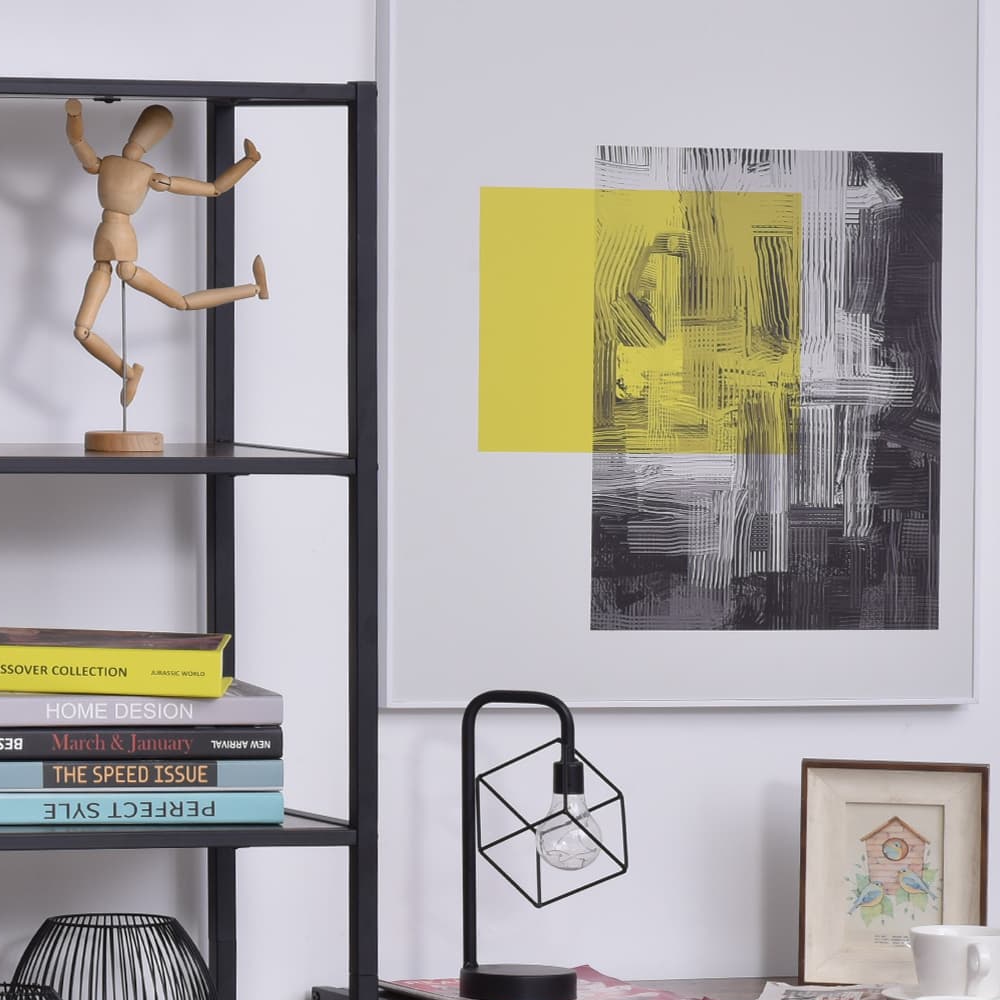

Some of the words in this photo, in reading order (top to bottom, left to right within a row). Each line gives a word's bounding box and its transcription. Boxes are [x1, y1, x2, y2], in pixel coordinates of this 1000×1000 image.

[51, 665, 128, 678] COLLECTION
[46, 702, 108, 720] HOME
[50, 733, 106, 751] March
[110, 733, 125, 751] &
[127, 733, 193, 755] January
[210, 739, 248, 749] ARRIVAL
[249, 740, 272, 749] NEW
[52, 765, 88, 784] THE
[92, 765, 149, 784] SPEED
[153, 764, 209, 784] ISSUE
[43, 802, 100, 820] SYLE
[107, 800, 216, 818] PERFECT
